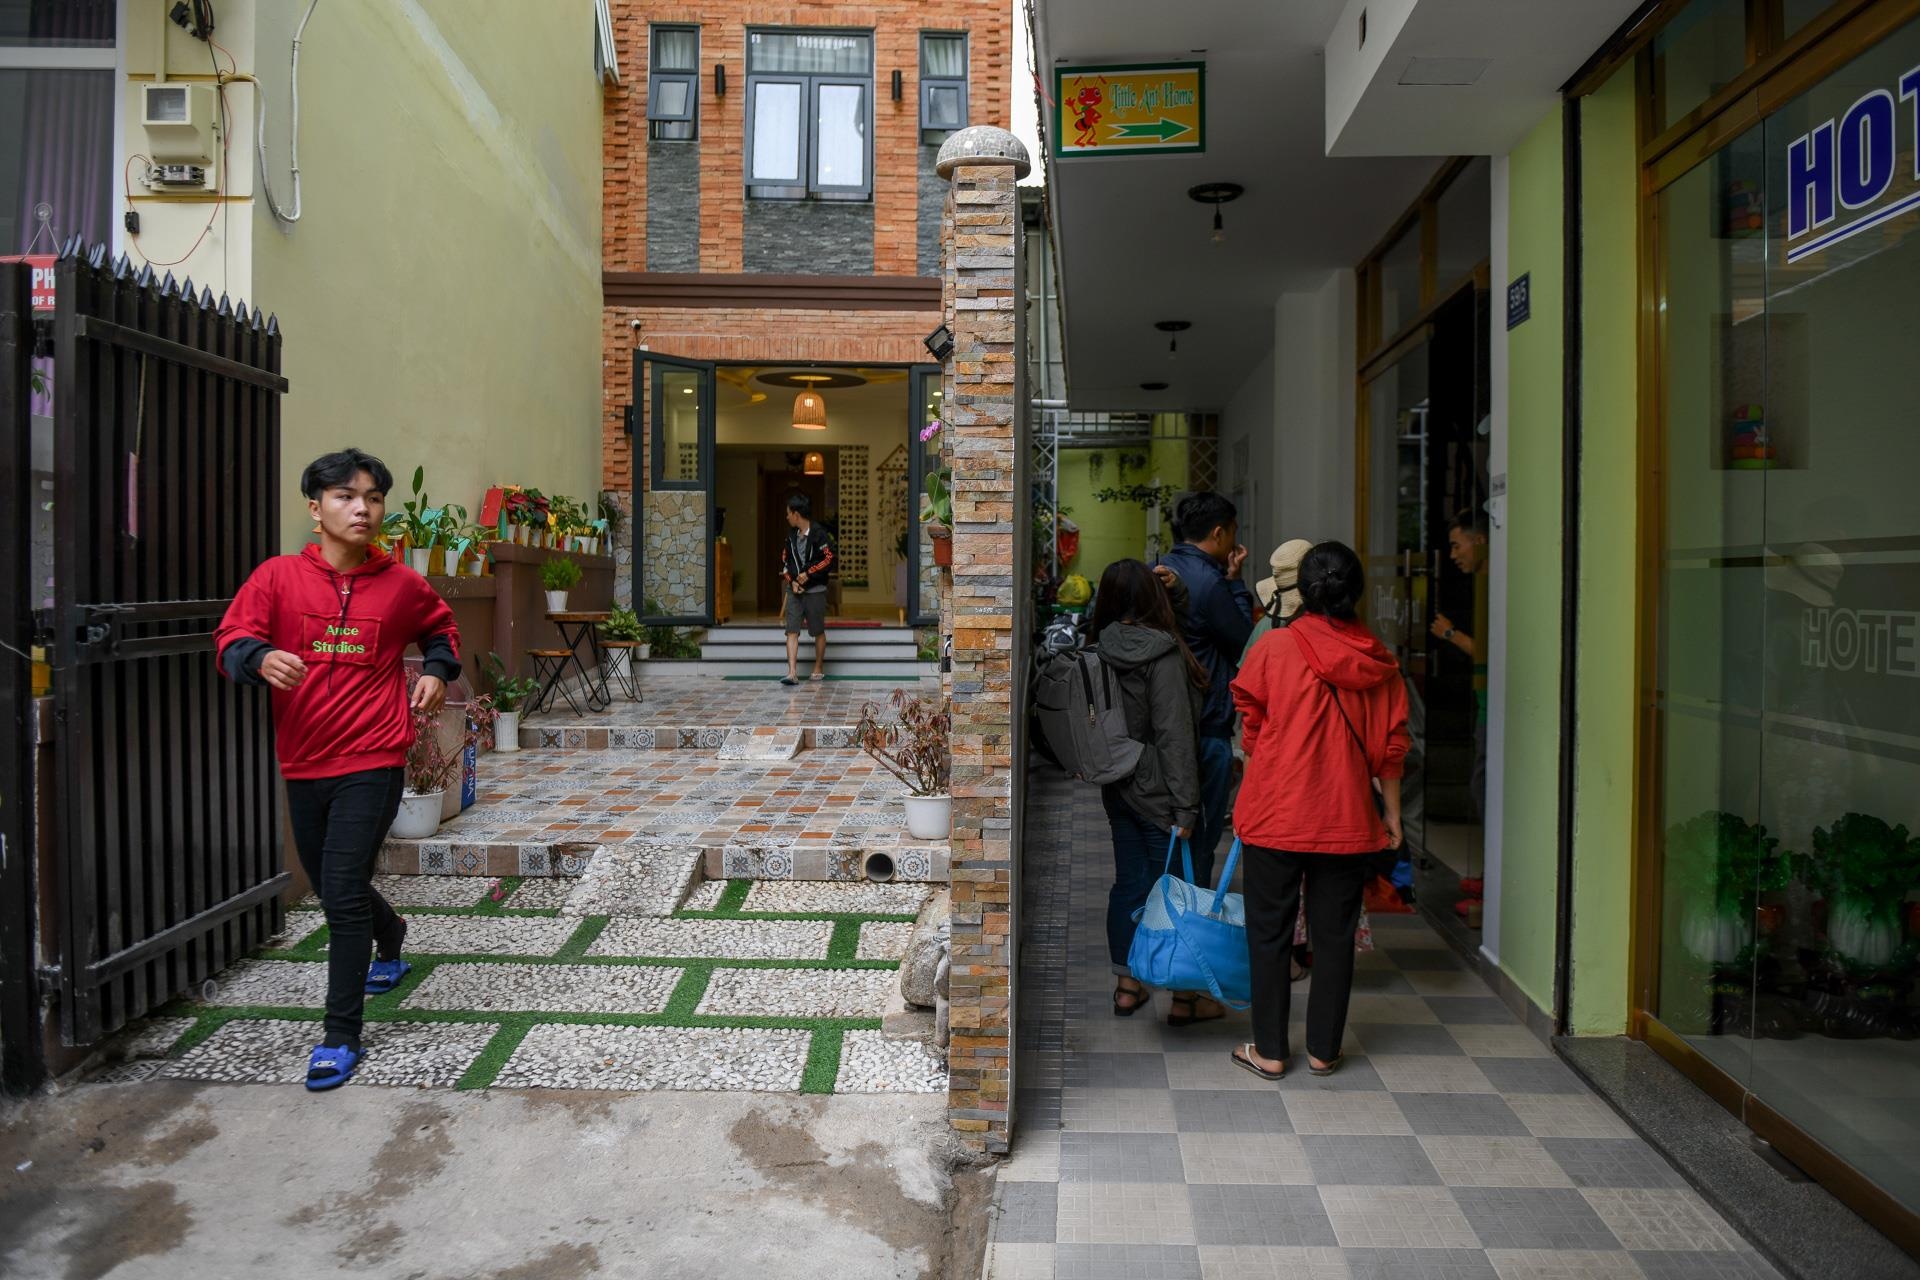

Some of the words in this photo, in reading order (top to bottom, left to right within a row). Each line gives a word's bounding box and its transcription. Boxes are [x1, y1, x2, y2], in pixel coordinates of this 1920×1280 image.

[1138, 84, 1160, 116] Ant
[1162, 81, 1194, 109] Home
[312, 640, 365, 654] Studios
